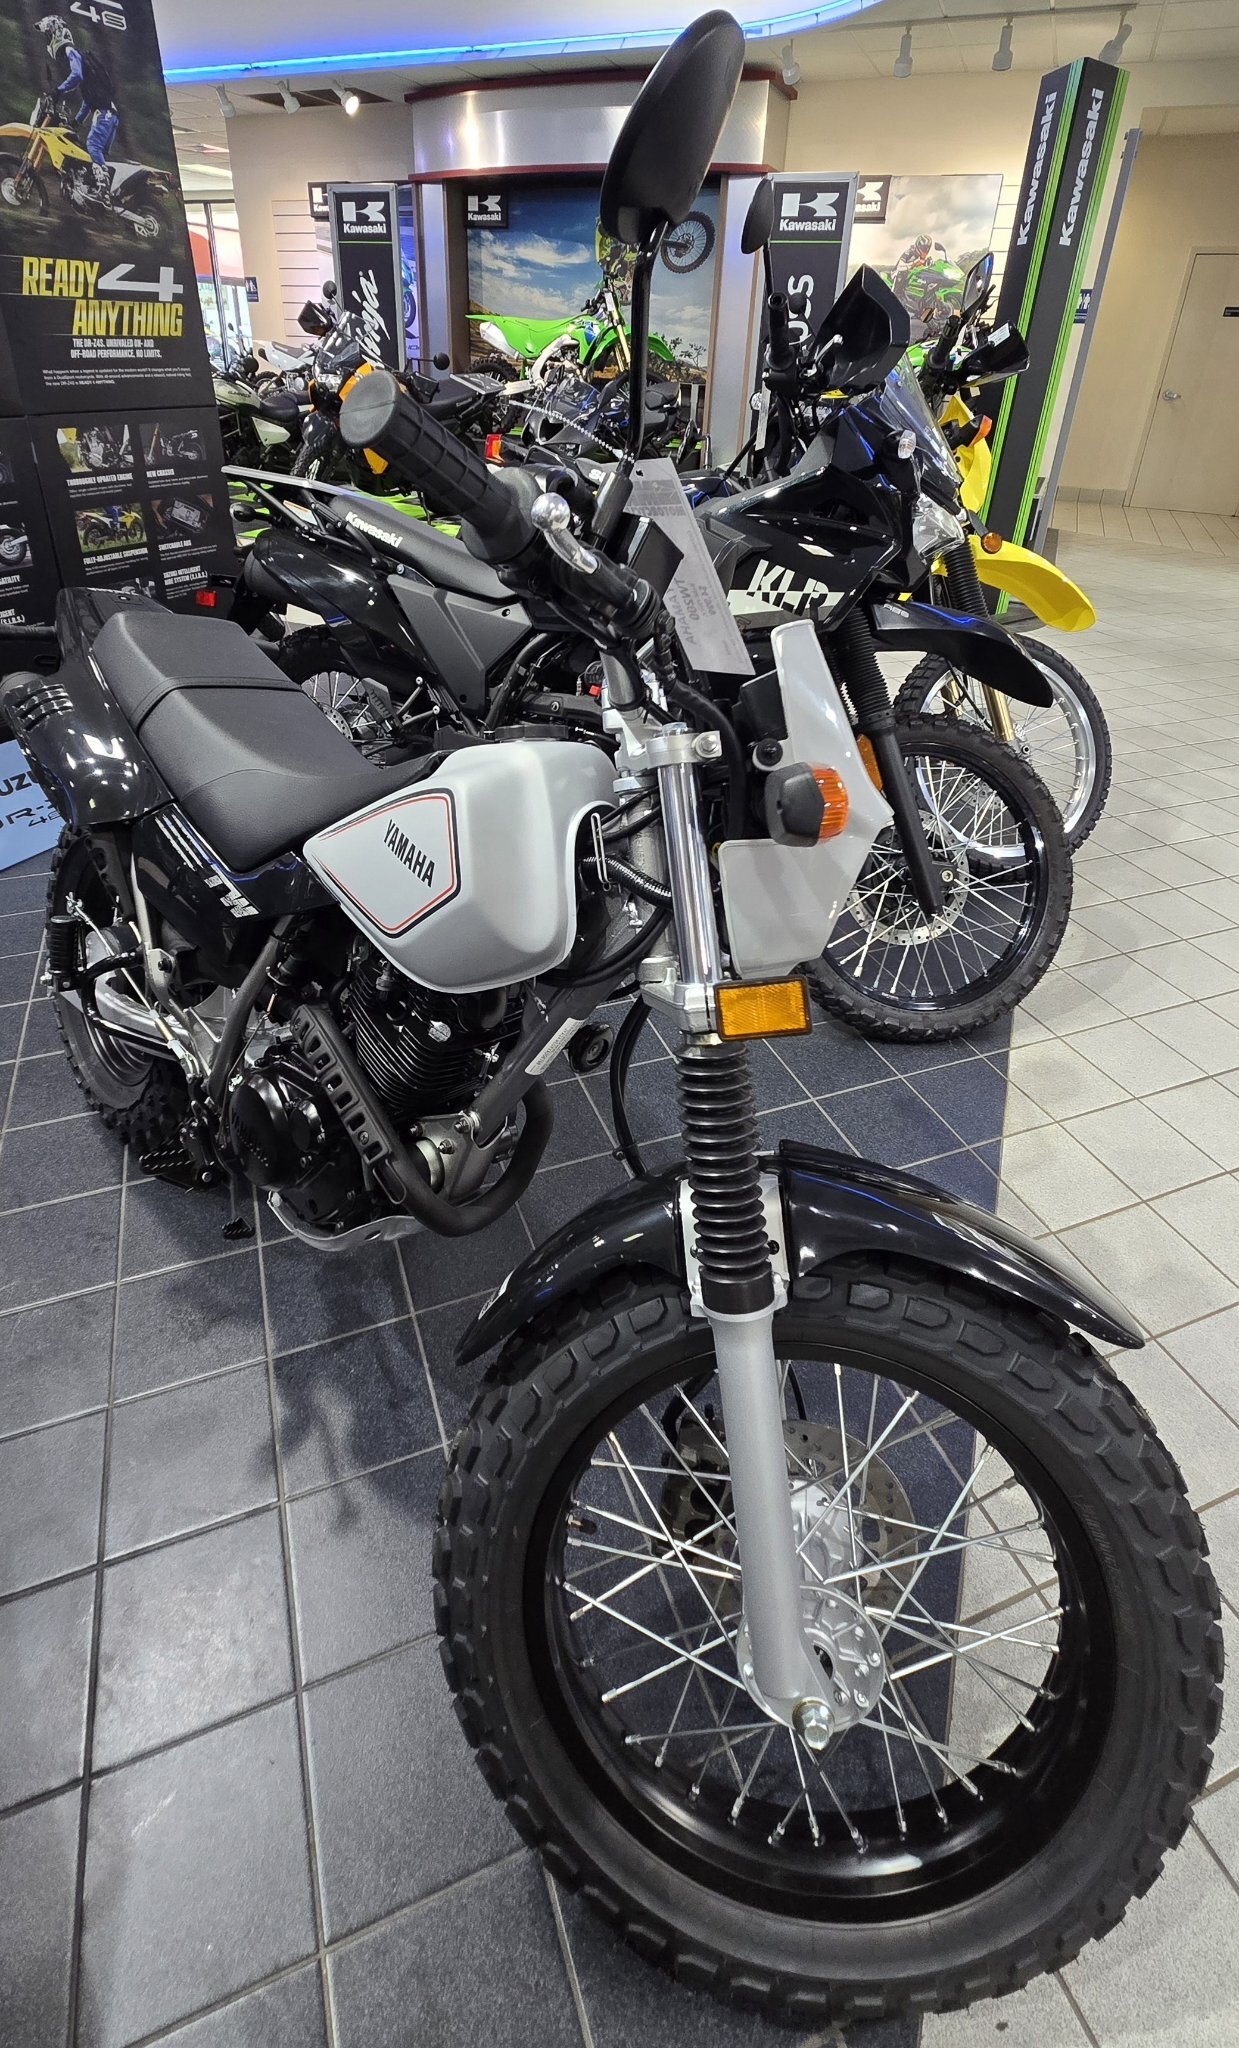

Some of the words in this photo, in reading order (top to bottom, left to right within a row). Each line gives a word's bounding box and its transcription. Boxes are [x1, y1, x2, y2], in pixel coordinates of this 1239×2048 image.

[1017, 91, 1058, 246] Kawasaki
[1059, 88, 1105, 246] Kawasaki
[343, 223, 387, 234] Kawasaki
[468, 212, 502, 221] Kawasaki
[780, 218, 837, 231] Kawasaki
[22, 256, 100, 298] READY
[98, 263, 184, 302] 4
[72, 299, 184, 337] ANYTHING
[71, 350, 96, 358] OFF-ROAD
[73, 338, 83, 347] THE
[106, 339, 133, 348] UNRIVALED
[345, 511, 403, 548] Kawasaki
[383, 819, 436, 888] YAMAHA
